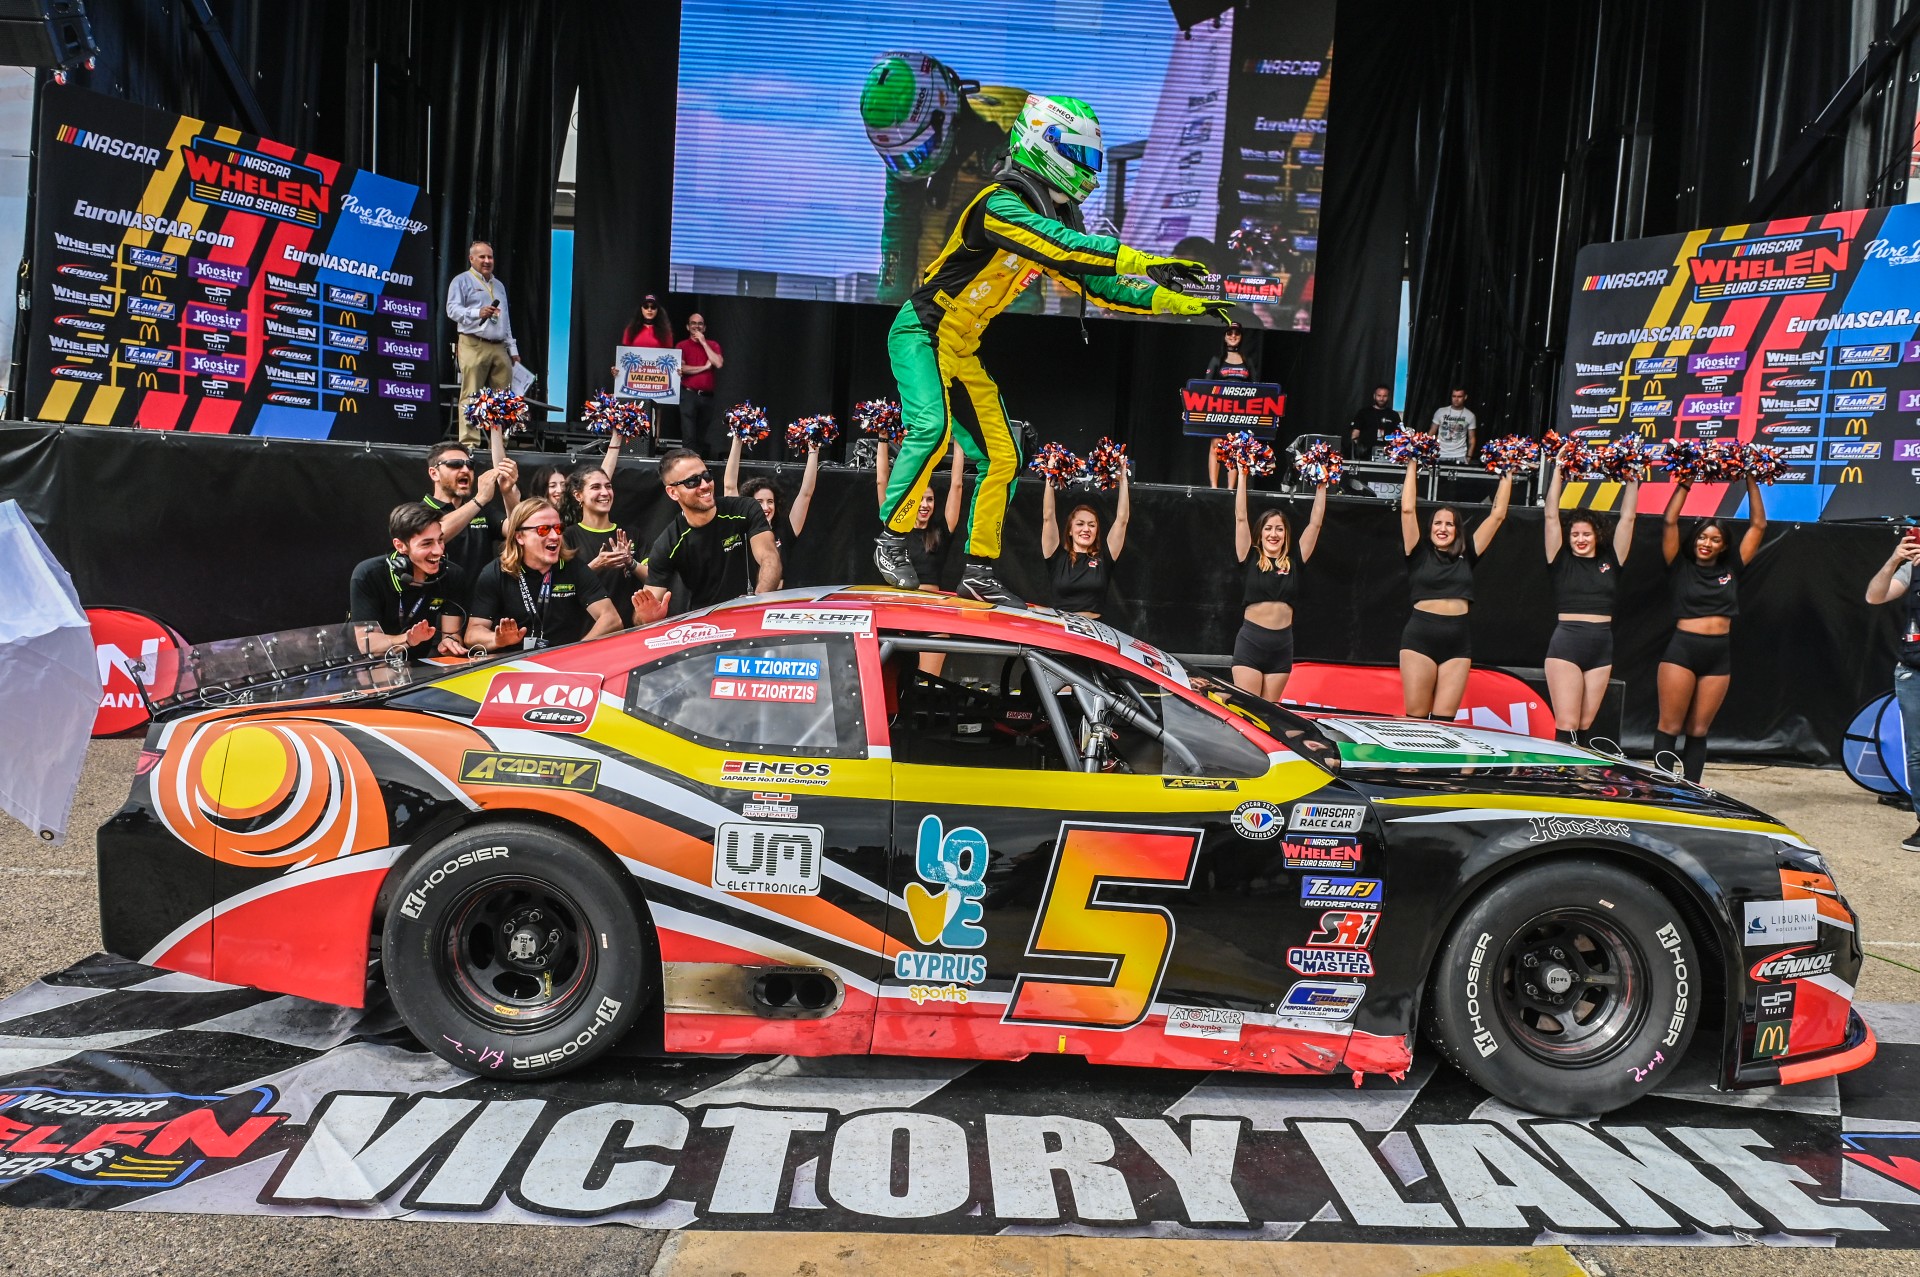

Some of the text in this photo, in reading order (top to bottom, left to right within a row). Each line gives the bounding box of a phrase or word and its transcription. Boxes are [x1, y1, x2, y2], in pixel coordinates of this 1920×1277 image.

[1260, 60, 1321, 75] NASCAR
[1053, 106, 1075, 122] ENEOS
[82, 132, 160, 166] NASCAR
[243, 156, 291, 178] NASCAR
[184, 148, 330, 213] WHELEN
[220, 190, 297, 218] EURO SERIES
[340, 194, 372, 217] Pure
[376, 206, 428, 234] Racing
[73, 199, 235, 248] EuroNASCAR.com
[54, 232, 115, 255] WHELEN
[1749, 238, 1803, 256] NASCAR
[1864, 239, 1908, 260] Pure
[283, 244, 414, 286] EuroNASCAR.com
[1690, 241, 1850, 284] WHELEN
[60, 267, 108, 280] KENNOL
[195, 262, 242, 280] Hoosier
[267, 274, 317, 293] WHELEN
[1602, 269, 1668, 290] NASCAR
[1723, 277, 1806, 295] EURO SERIES
[52, 284, 112, 304] WHELEN
[1224, 280, 1283, 296] WHELEN
[273, 304, 313, 316] KENNOL
[382, 300, 421, 314] Hoosier
[58, 318, 106, 330] KENNOL
[193, 310, 241, 326] Hoosier
[266, 320, 316, 338] WHELEN
[1592, 324, 1735, 346] EuroNASCAR.com
[49, 334, 110, 354] WHELEN
[383, 342, 423, 356] Hoosier
[272, 350, 312, 361] KENNOL
[1693, 355, 1740, 369] Hoosier
[1766, 350, 1825, 362] WHELEN
[191, 357, 240, 372] Hoosier
[1576, 361, 1624, 372] WHELEN
[55, 368, 103, 379] KENNOL
[265, 365, 315, 381] WHELEN
[631, 374, 666, 382] VALENCIA
[384, 384, 424, 396] Hoosier
[1222, 386, 1257, 396] NASCAR
[271, 394, 311, 404] KENNOL
[1182, 390, 1286, 416] WHELEN
[1688, 400, 1735, 413] Hoosier
[1761, 397, 1820, 408] WHELEN
[1571, 404, 1618, 414] WHELEN
[1205, 414, 1259, 424] EURO SERIES
[818, 614, 869, 622] CAFFI
[741, 660, 818, 676] V. TZIORTZIS
[490, 684, 594, 708] ALCO
[737, 683, 815, 700] V. TZIORTZIS
[465, 757, 593, 784] ACADEMY
[743, 762, 830, 776] ENEOS
[1167, 779, 1232, 789] ACADEMY
[744, 804, 798, 812] PSALTIS
[1238, 802, 1277, 814] NASCAR 75TH
[1315, 807, 1355, 818] NASCAR
[1237, 825, 1278, 838] ANNIVERSARY
[1300, 820, 1352, 828] RACE CAR
[1529, 816, 1631, 842] Hoosier
[1282, 841, 1362, 861] WHELEN
[417, 846, 510, 899] HOOSIER
[727, 880, 807, 894] ELETTRONICA
[1304, 900, 1378, 909] MOTORSPORTS
[1002, 822, 1203, 1030] 5
[1771, 913, 1817, 925] LIBURNIA
[1290, 950, 1367, 965] QUARTER
[1756, 954, 1834, 977] KENNOL
[898, 952, 986, 983] CYPRUS
[1303, 961, 1370, 973] MASTER
[1785, 969, 1823, 979] PERFORMANCE
[1467, 932, 1493, 1034] HOOSIER
[1551, 975, 1568, 984] HOWE
[910, 984, 967, 1003] sports
[1661, 947, 1688, 1047] HOOSIER
[1170, 1007, 1244, 1024] ATOMIX-R
[513, 1019, 606, 1069] HOOSIER
[9, 1094, 168, 1117] NASCAR
[271, 1094, 1890, 1232] VICTORY LANE
